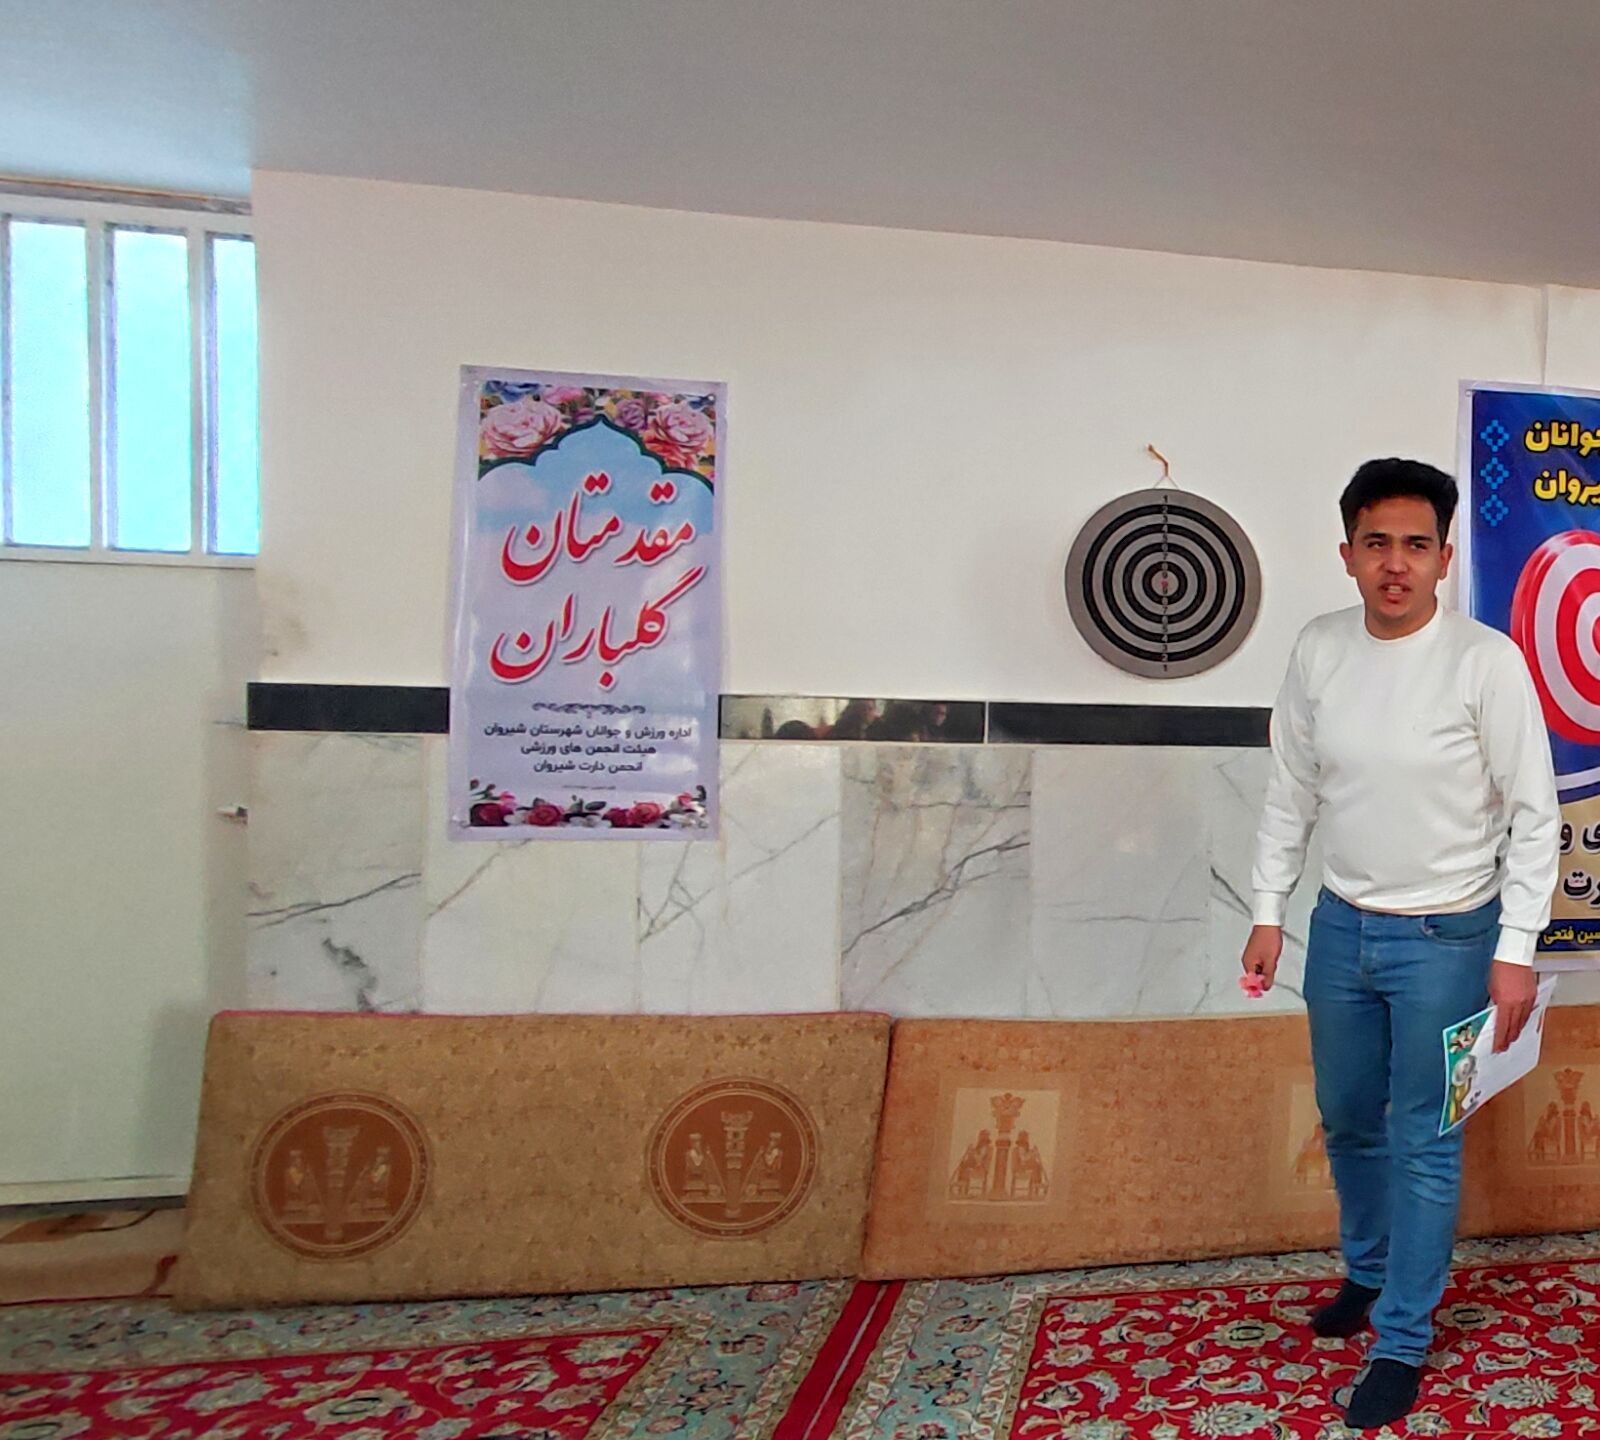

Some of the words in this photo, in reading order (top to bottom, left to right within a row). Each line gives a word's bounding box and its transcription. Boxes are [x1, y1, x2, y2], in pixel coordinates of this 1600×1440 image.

[502, 472, 695, 584] مقدمتان
[490, 567, 704, 689] گلباران
[484, 722, 527, 736] شیروان
[529, 724, 583, 738] شهرستان
[625, 729, 631, 739] و
[634, 725, 666, 739] ورزش
[668, 726, 692, 740] اداره
[520, 742, 556, 755] ورزشی
[559, 743, 582, 754] های
[585, 743, 620, 756] انجمن
[533, 759, 576, 773] شیروان
[578, 761, 605, 774] دارت
[608, 761, 643, 774] انجمن
[1543, 926, 1574, 945] فتحی
